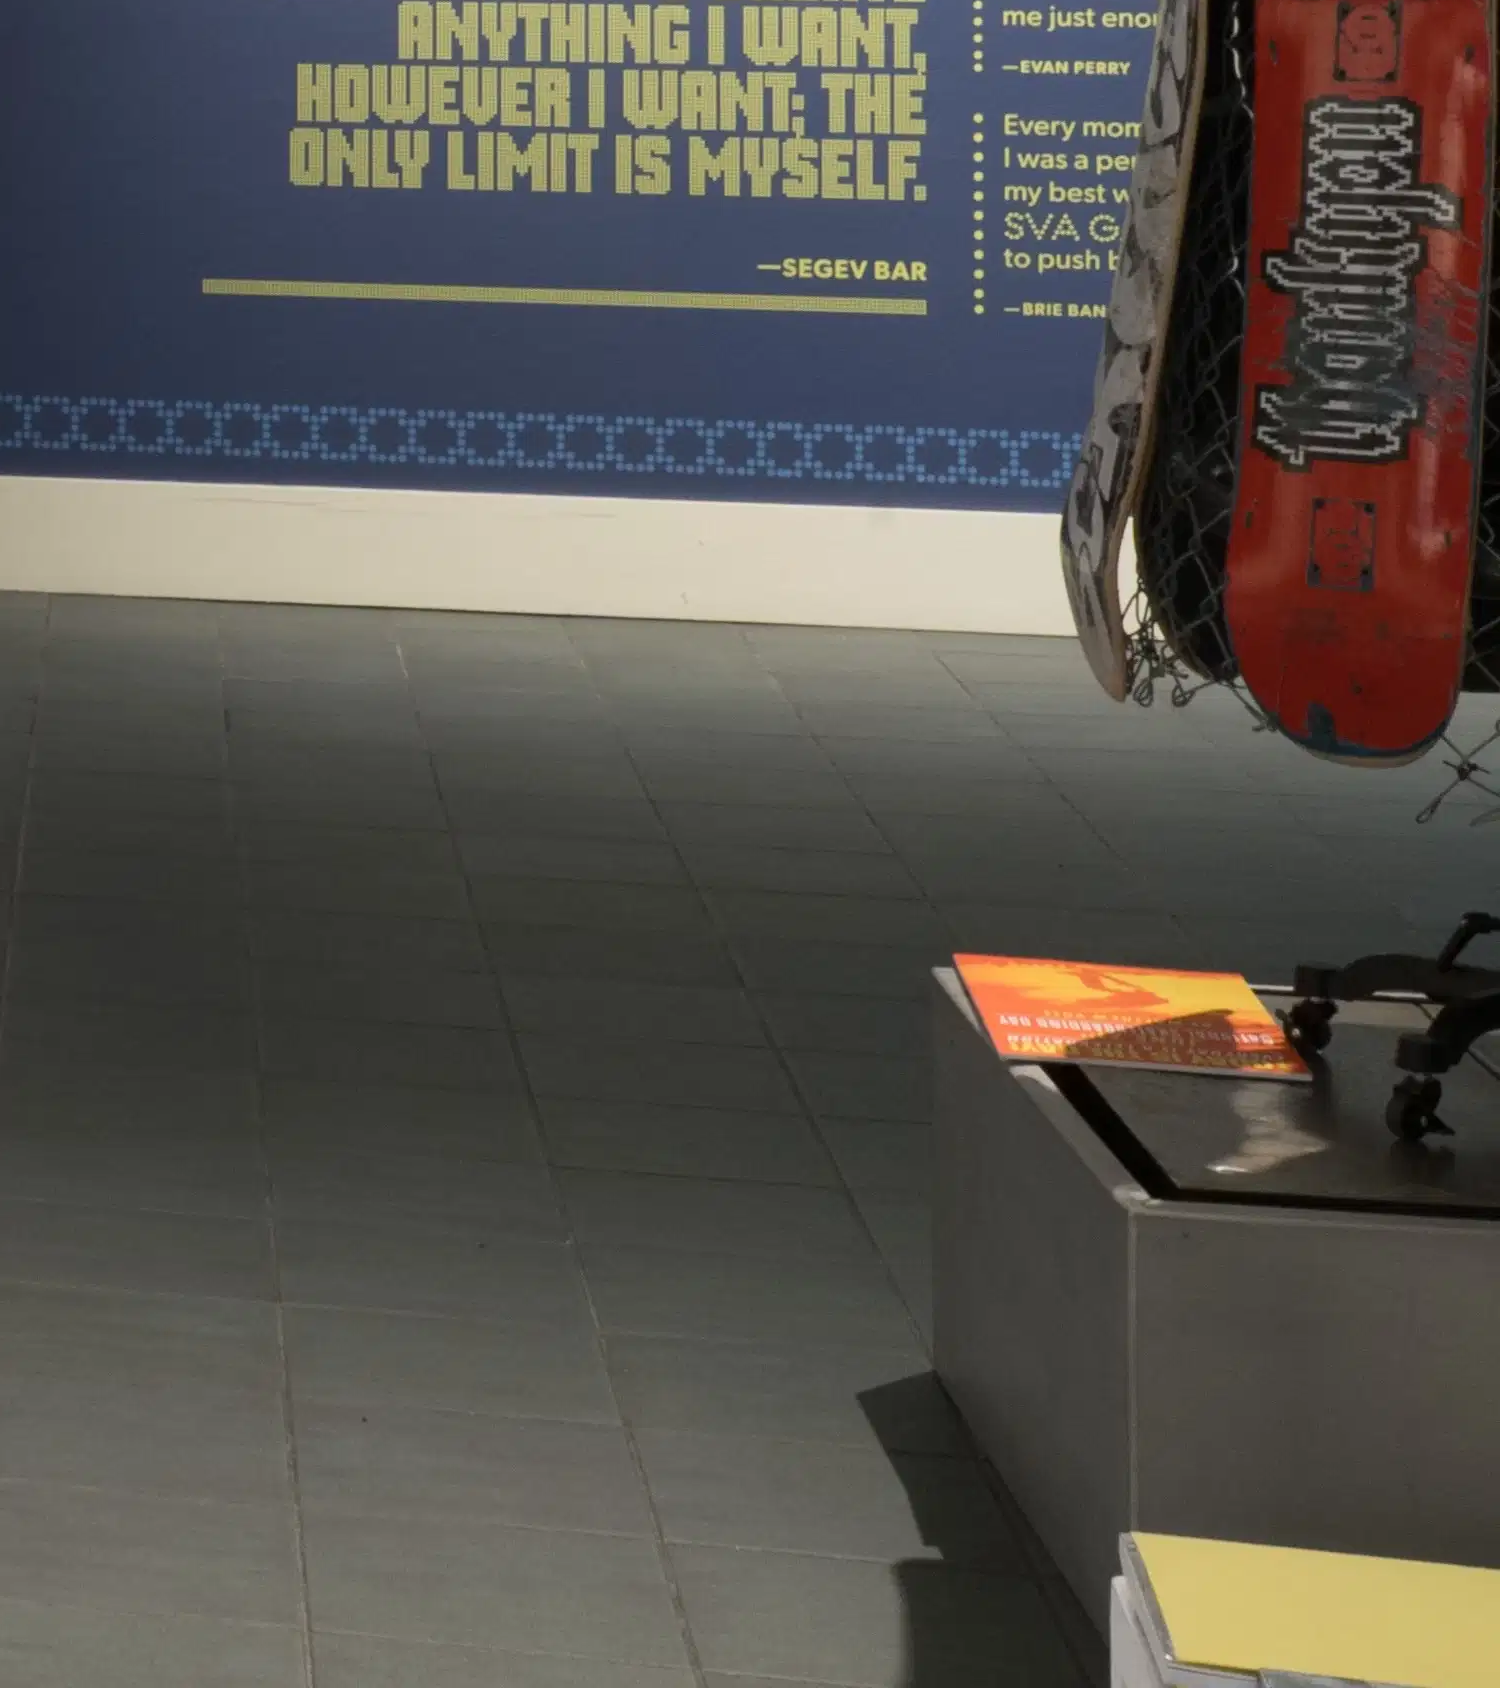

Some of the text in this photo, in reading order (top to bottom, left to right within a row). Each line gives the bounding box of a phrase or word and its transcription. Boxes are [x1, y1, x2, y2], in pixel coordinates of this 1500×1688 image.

[1002, 7, 1095, 31] me just
[398, 2, 928, 76] ANYTHING I WANT,
[1074, 61, 1130, 75] PERRY
[296, 64, 571, 125] HOWEVER
[588, 70, 606, 128] I
[821, 73, 926, 135] THE
[1004, 114, 1076, 141] Every
[289, 129, 927, 201] ONLY LIMIT IS MYSELF.
[1004, 148, 1088, 170] I was a
[1004, 185, 1041, 207] my
[1049, 181, 1105, 204] best
[1004, 212, 1123, 243] SVA G
[874, 260, 927, 282] BAR
[1004, 249, 1101, 274] to push
